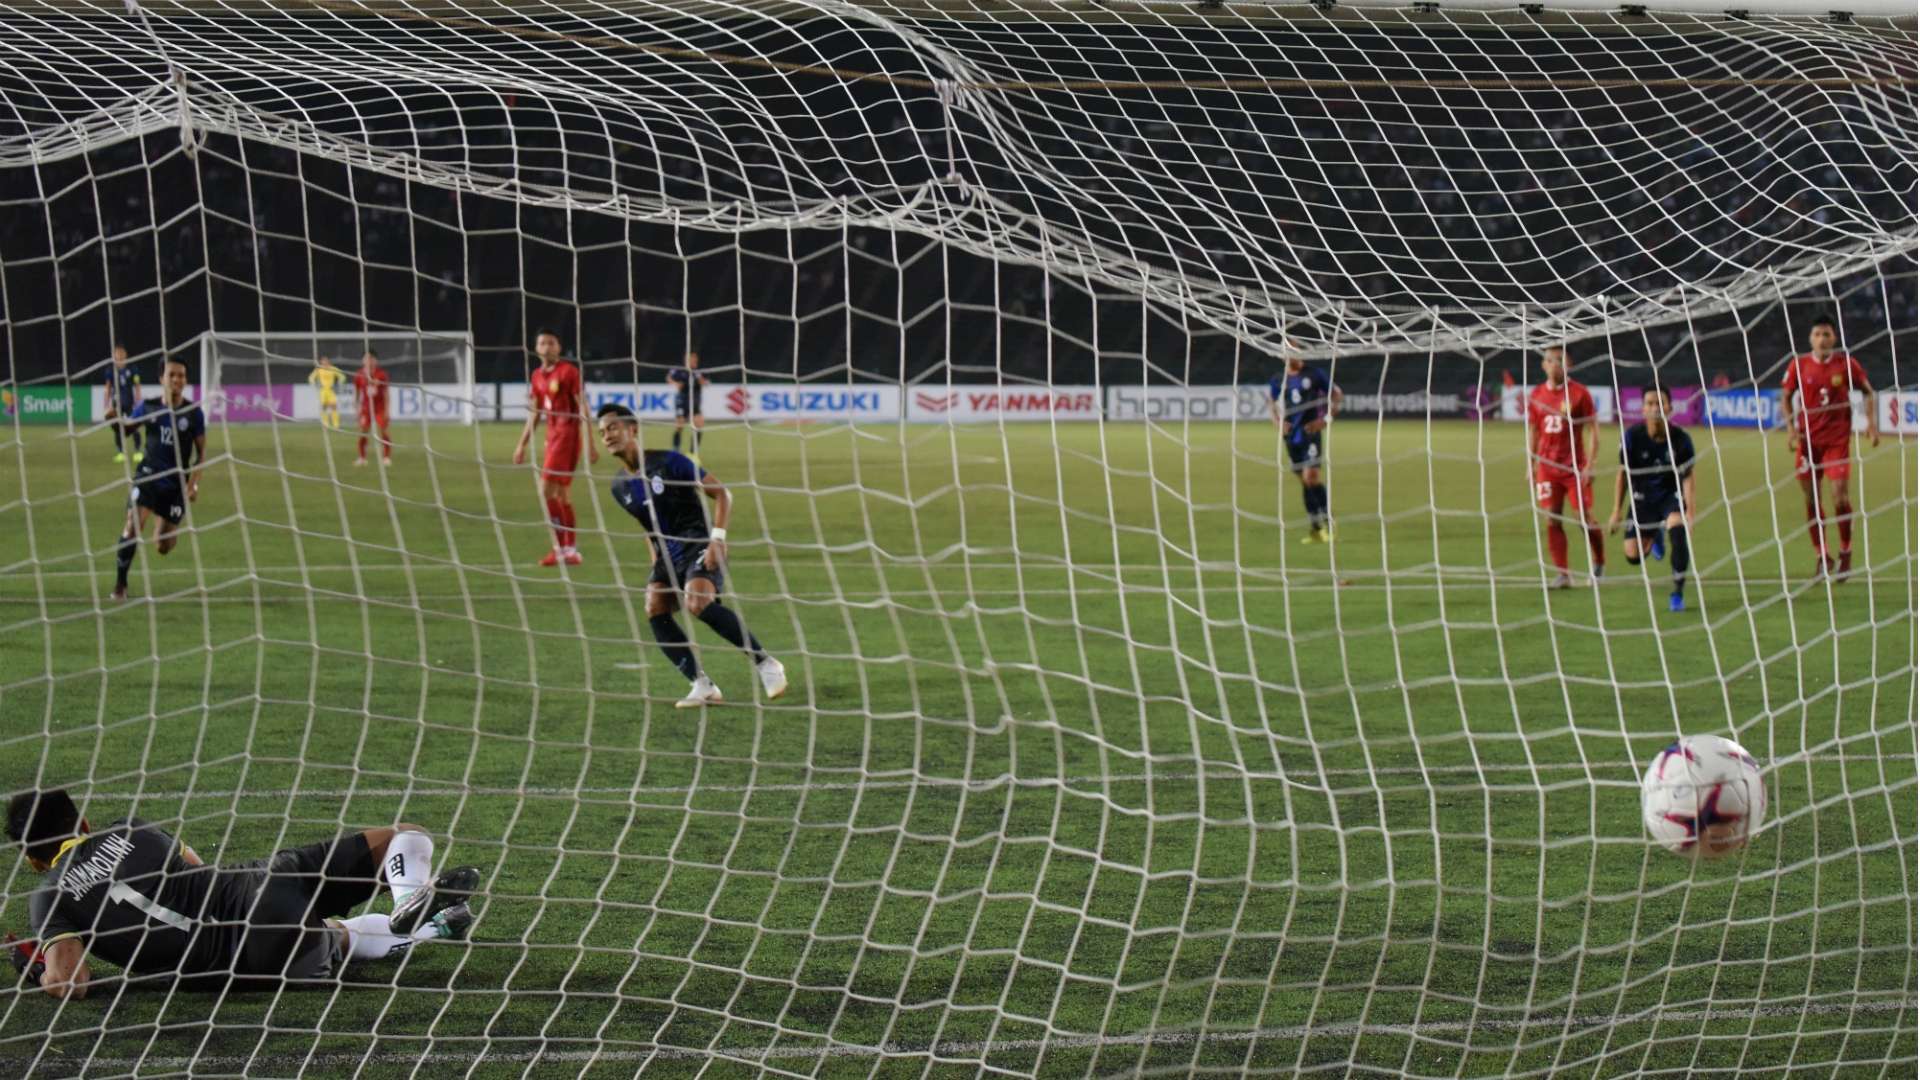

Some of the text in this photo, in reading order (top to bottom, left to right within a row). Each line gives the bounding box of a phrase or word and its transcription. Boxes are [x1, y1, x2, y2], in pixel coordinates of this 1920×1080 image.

[586, 391, 671, 412] UZUK
[760, 392, 880, 411] SUZUKI
[967, 393, 1094, 412] YANMAR
[1116, 388, 1228, 417] honor
[1704, 395, 1771, 419] PINACO
[160, 425, 174, 444] 12
[1544, 415, 1563, 434] 23
[109, 880, 193, 933] 1
